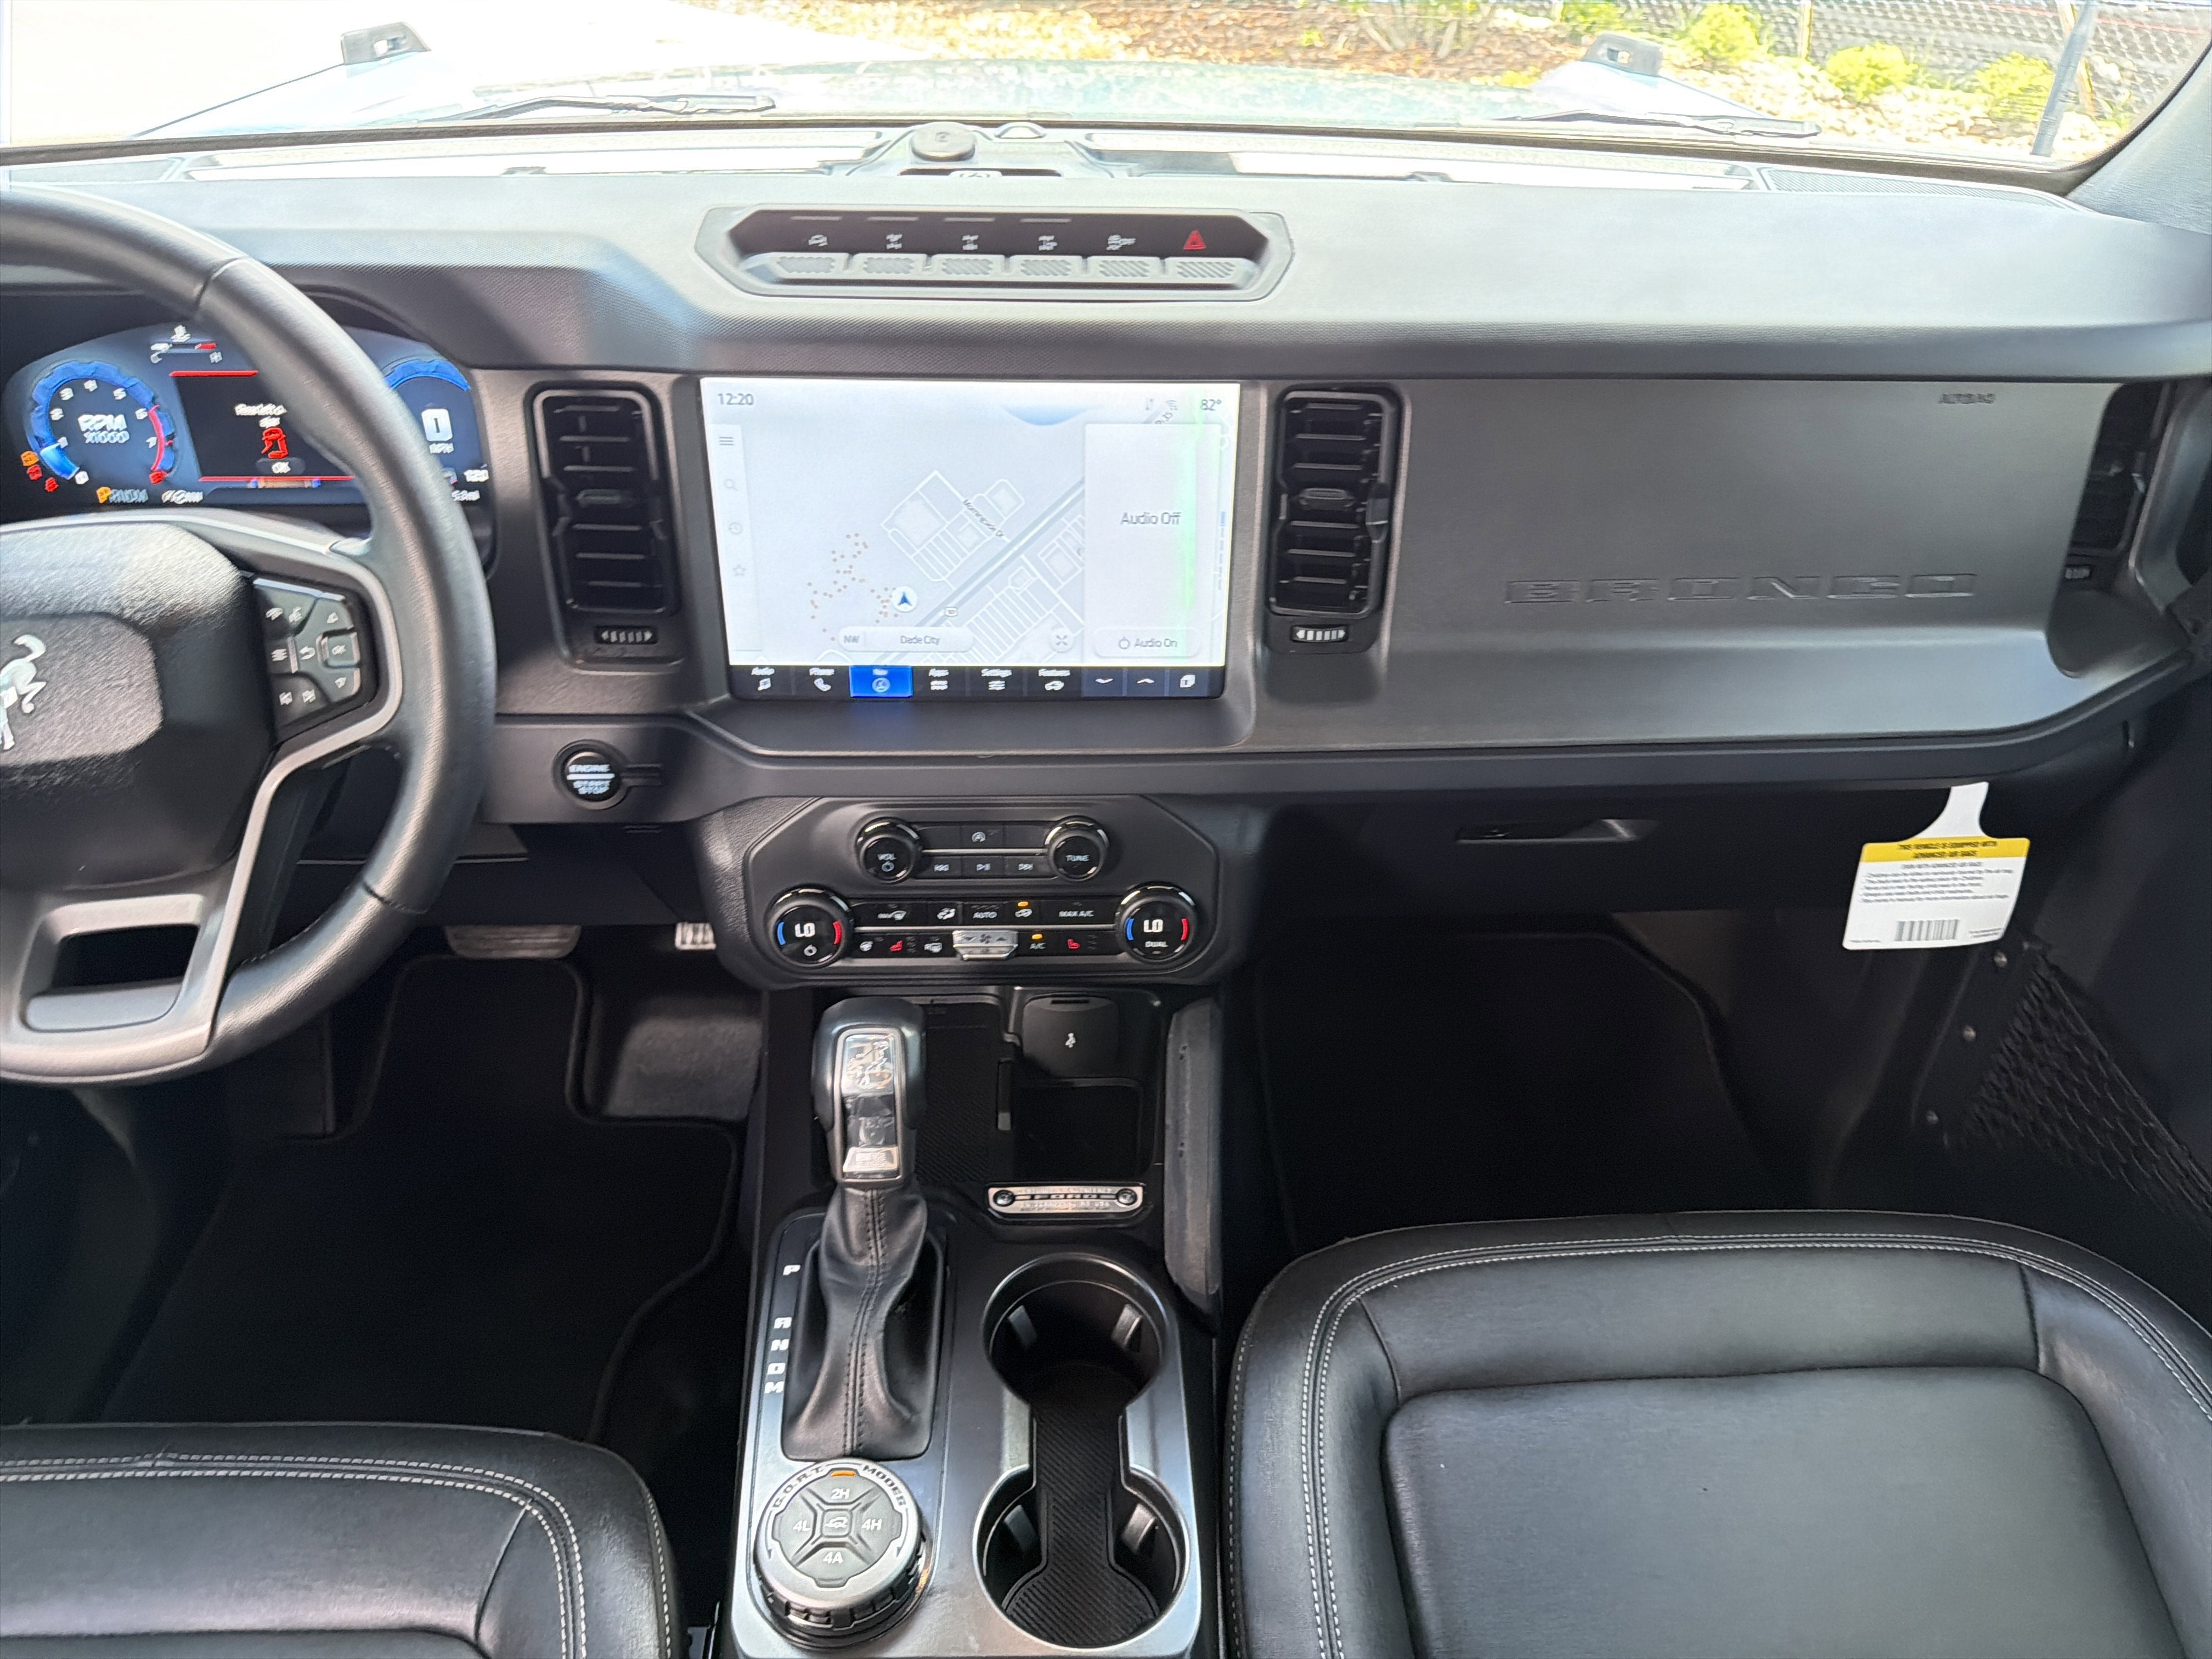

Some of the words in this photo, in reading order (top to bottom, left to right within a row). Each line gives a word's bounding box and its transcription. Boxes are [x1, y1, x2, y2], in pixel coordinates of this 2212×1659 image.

[718, 393, 754, 405] 12:20
[77, 414, 127, 432] RPM
[1120, 512, 1159, 524] Audio
[1161, 512, 1182, 524] Off
[1504, 573, 1978, 604] BRONCO
[844, 635, 860, 644] NW
[900, 635, 922, 644] Dade
[923, 635, 941, 645] City
[1134, 639, 1162, 648] Audio
[1164, 639, 1178, 648] On
[973, 911, 997, 919] AUTO
[794, 923, 816, 938] LO
[1143, 919, 1164, 933] LO
[782, 1265, 801, 1276] P
[770, 1339, 790, 1351] N
[767, 1362, 786, 1375] D
[764, 1381, 785, 1394] M
[831, 1488, 850, 1500] 2H
[792, 1520, 811, 1532] 4L
[861, 1519, 883, 1531] 4H
[822, 1551, 844, 1564] 4A
